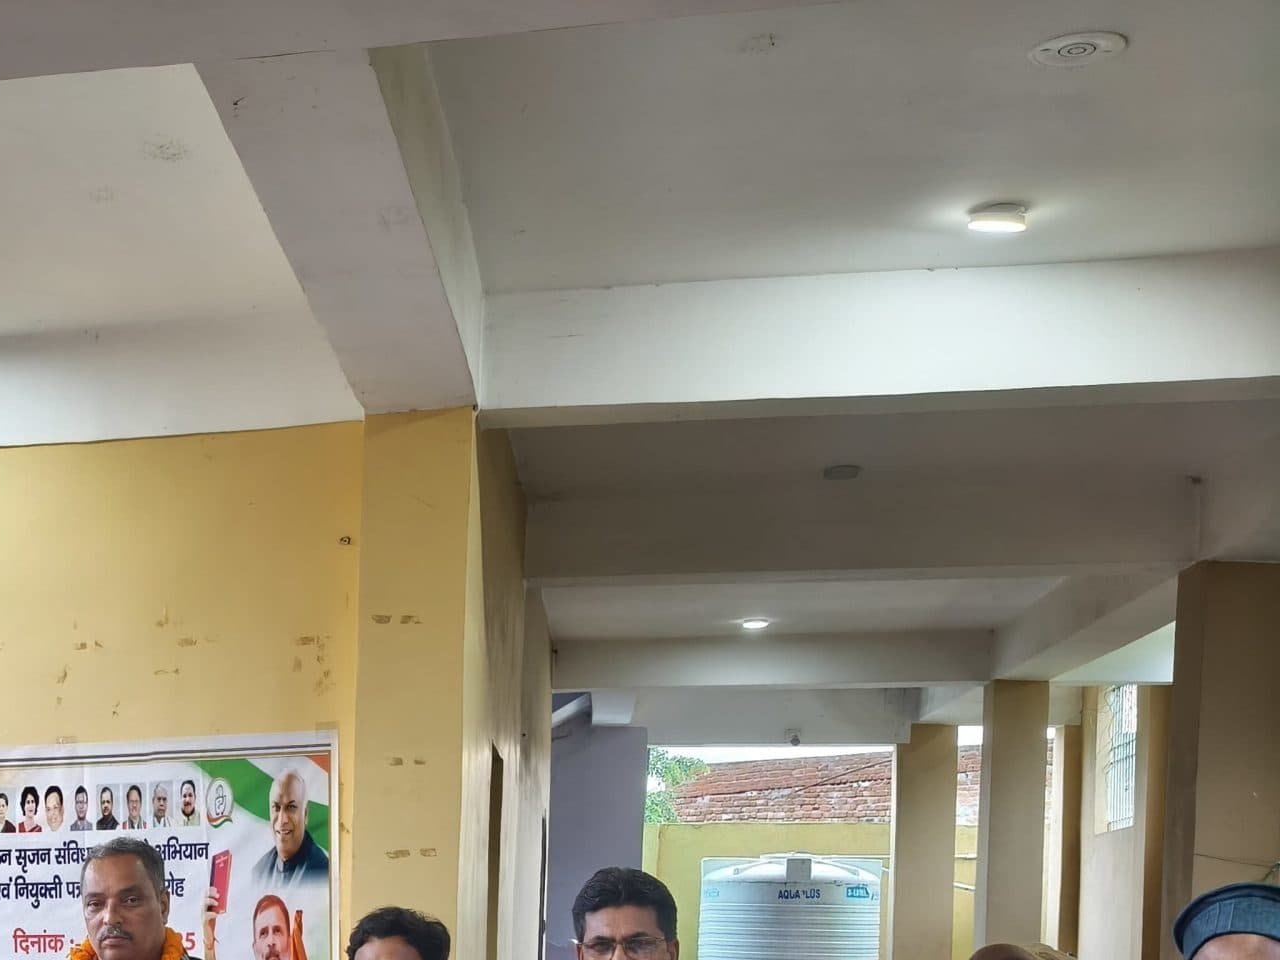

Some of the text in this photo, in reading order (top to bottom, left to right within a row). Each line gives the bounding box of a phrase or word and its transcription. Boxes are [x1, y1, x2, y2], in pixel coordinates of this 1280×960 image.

[16, 847, 51, 873] सृजन
[778, 889, 800, 900] AQUA
[13, 927, 65, 954] दिनांक
